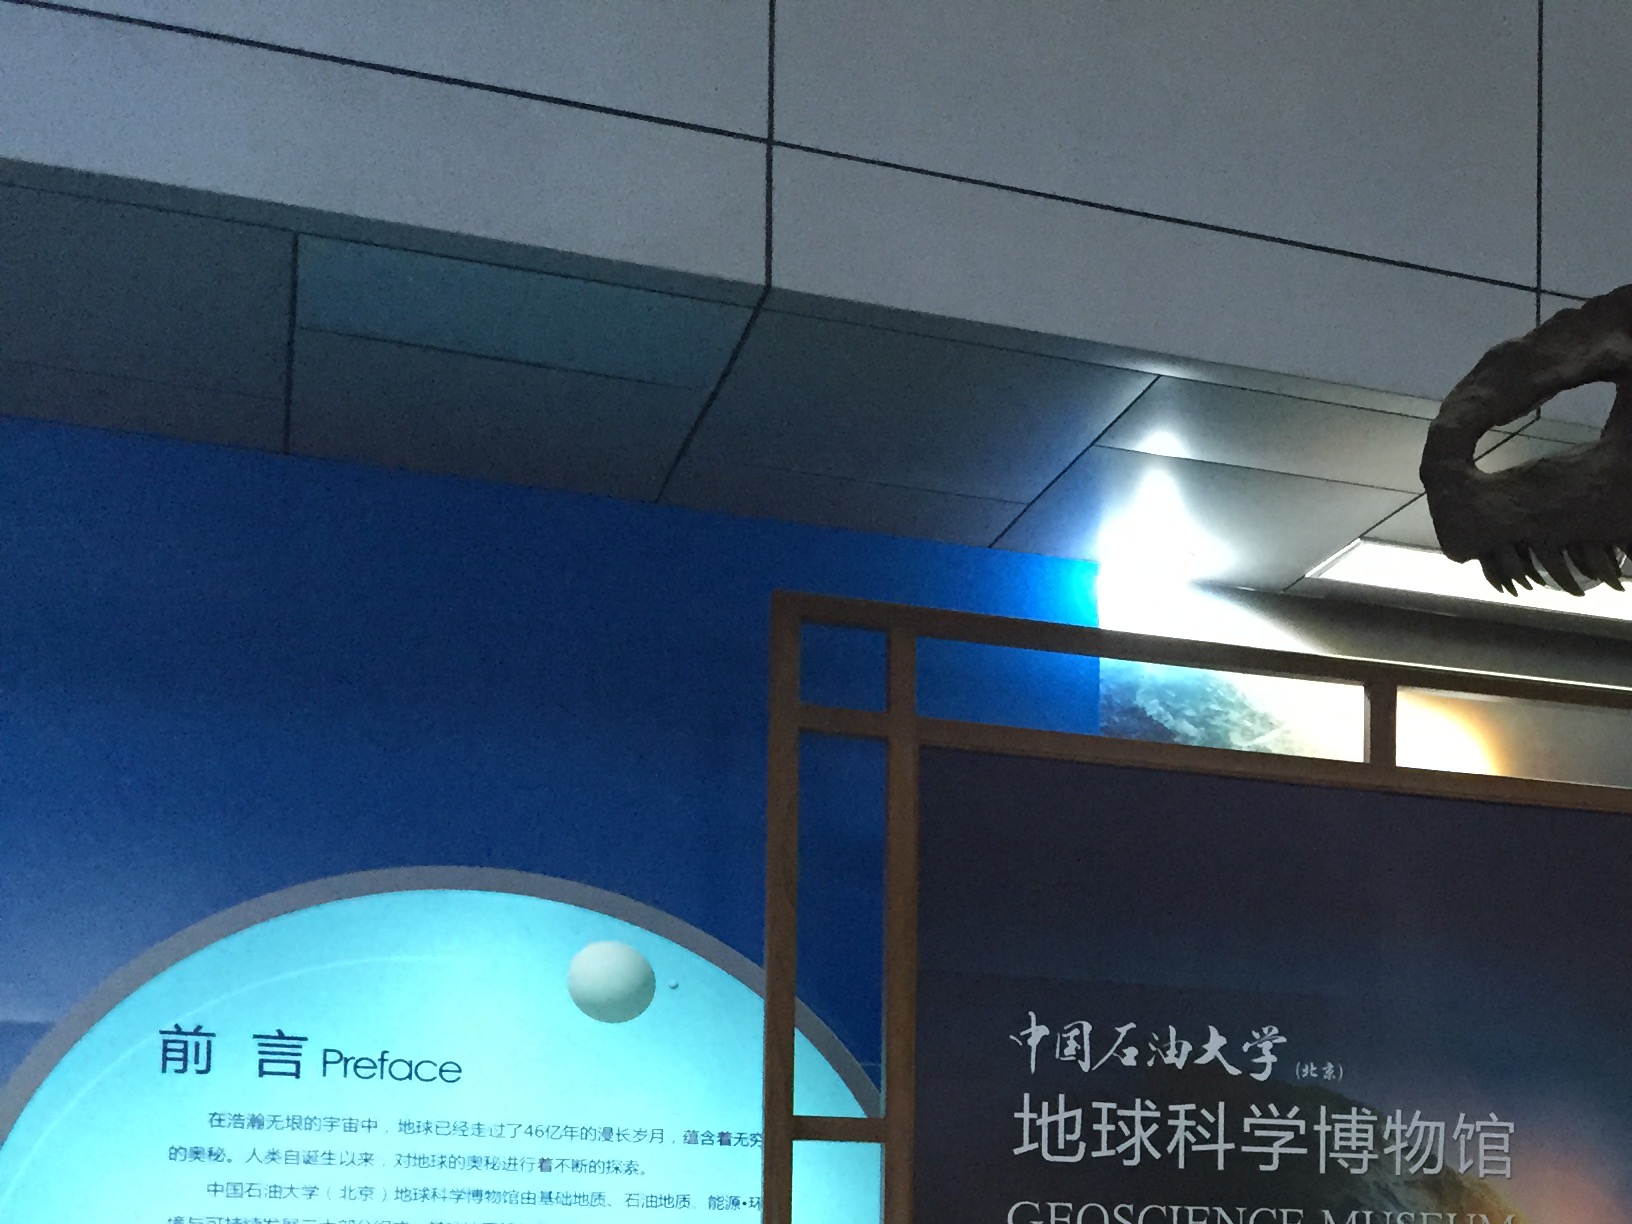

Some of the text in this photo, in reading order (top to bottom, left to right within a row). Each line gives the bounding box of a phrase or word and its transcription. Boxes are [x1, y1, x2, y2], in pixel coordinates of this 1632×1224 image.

[321, 1048, 463, 1085] Preface
[1009, 1011, 1287, 1081] 中国石油大学
[1011, 1092, 1516, 1180] 地球科学博物馆
